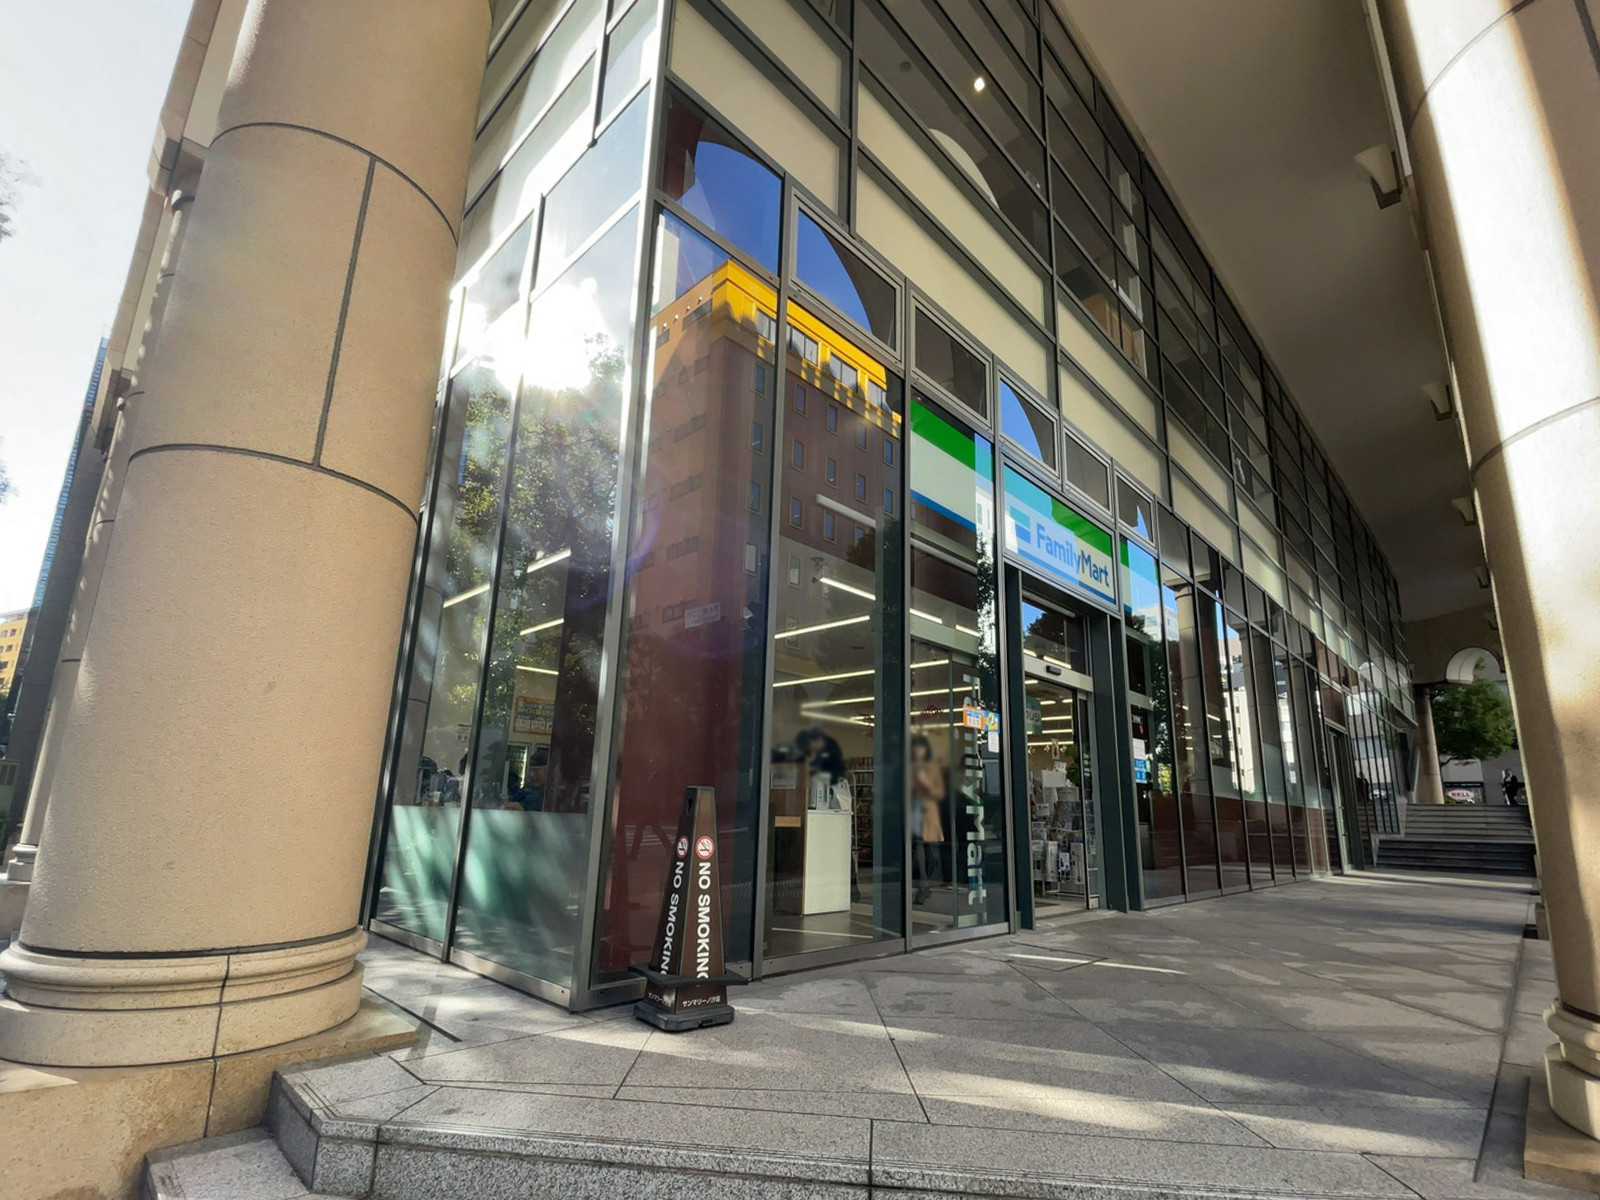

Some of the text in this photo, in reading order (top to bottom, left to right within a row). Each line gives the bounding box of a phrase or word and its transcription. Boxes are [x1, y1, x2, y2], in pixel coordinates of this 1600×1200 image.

[1036, 523, 1110, 588] FamilyMart
[673, 861, 685, 889] NO
[698, 862, 711, 890] NO
